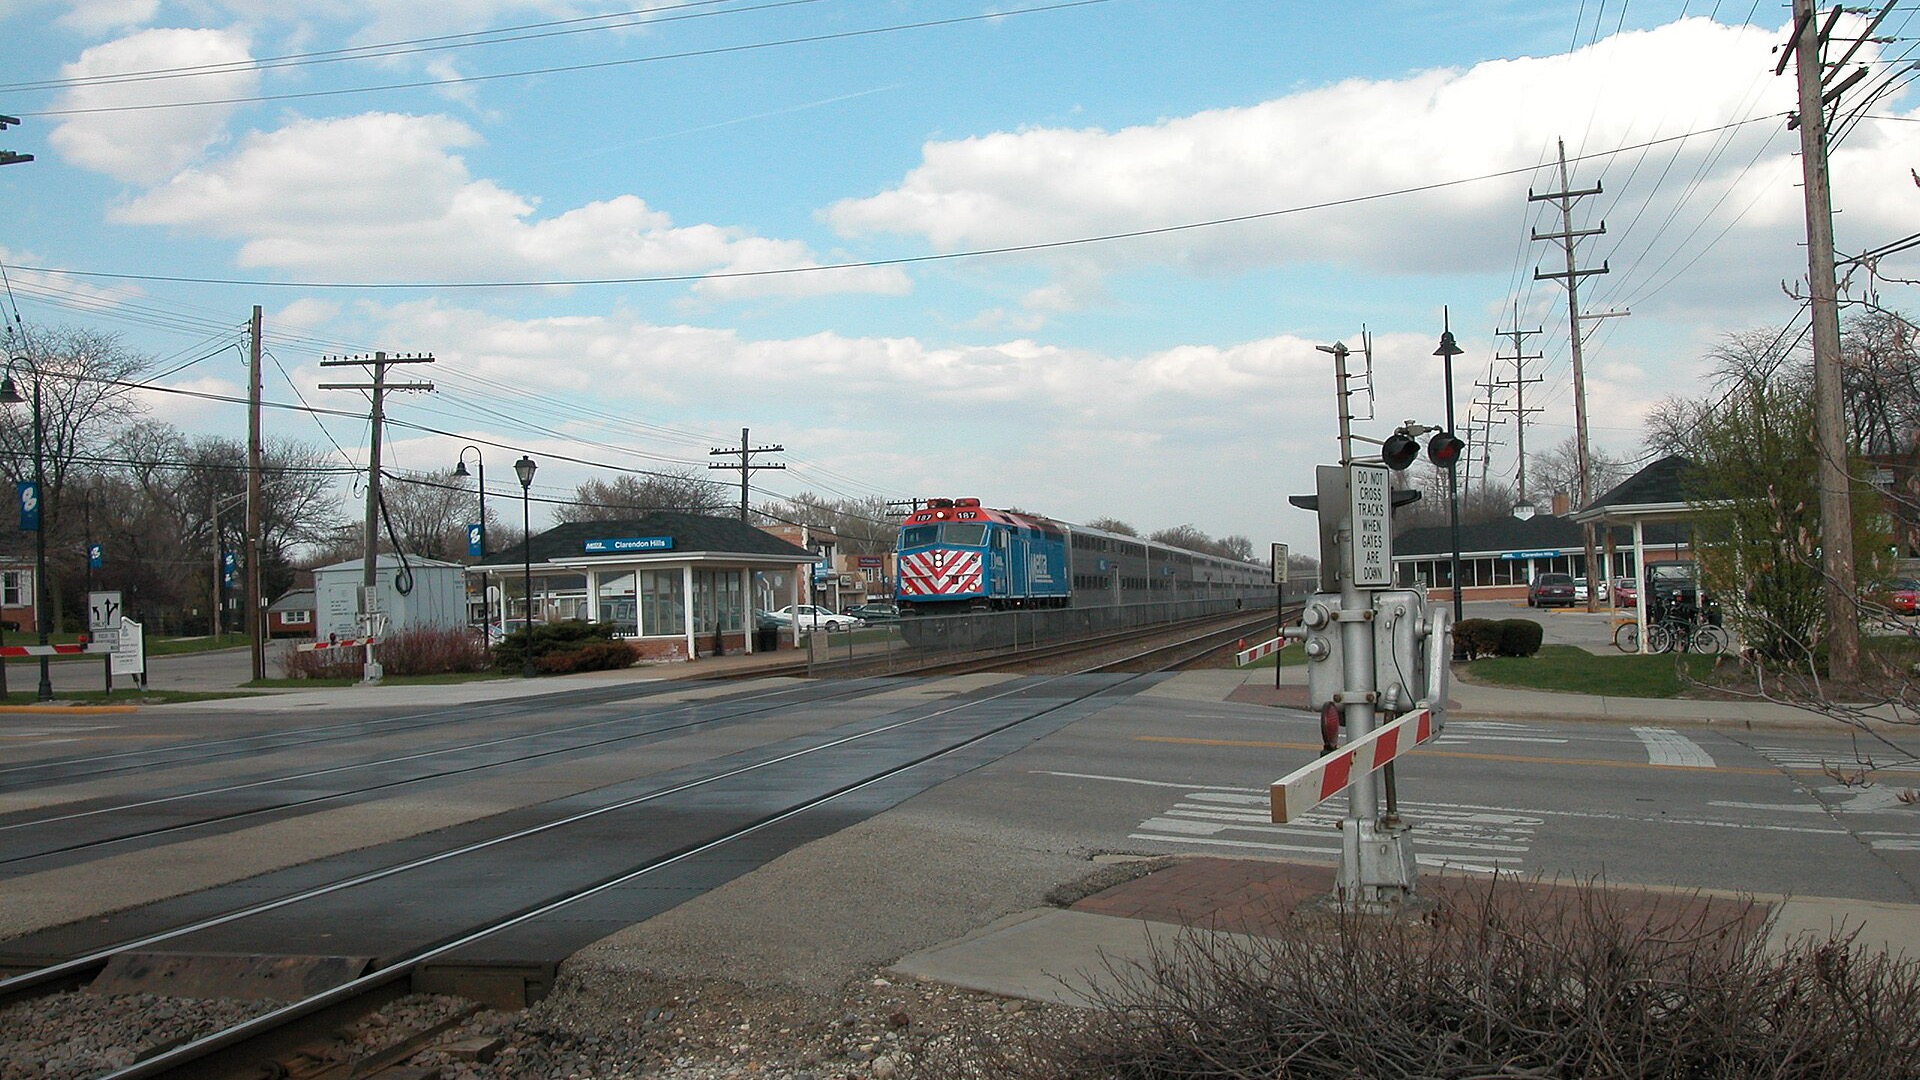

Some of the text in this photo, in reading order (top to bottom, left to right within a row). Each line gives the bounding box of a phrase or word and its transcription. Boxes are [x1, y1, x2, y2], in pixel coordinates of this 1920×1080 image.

[1358, 470, 1383, 486] DO NOT
[1360, 487, 1382, 501] CROSS
[1358, 503, 1384, 517] TRACKS
[917, 514, 932, 522] 187
[1362, 519, 1382, 533] WHEN
[614, 540, 649, 549] Clarendon
[650, 539, 666, 547] Hills
[1362, 535, 1383, 549] GATES
[1366, 551, 1380, 564] ARE
[1363, 566, 1383, 580] DOWN
